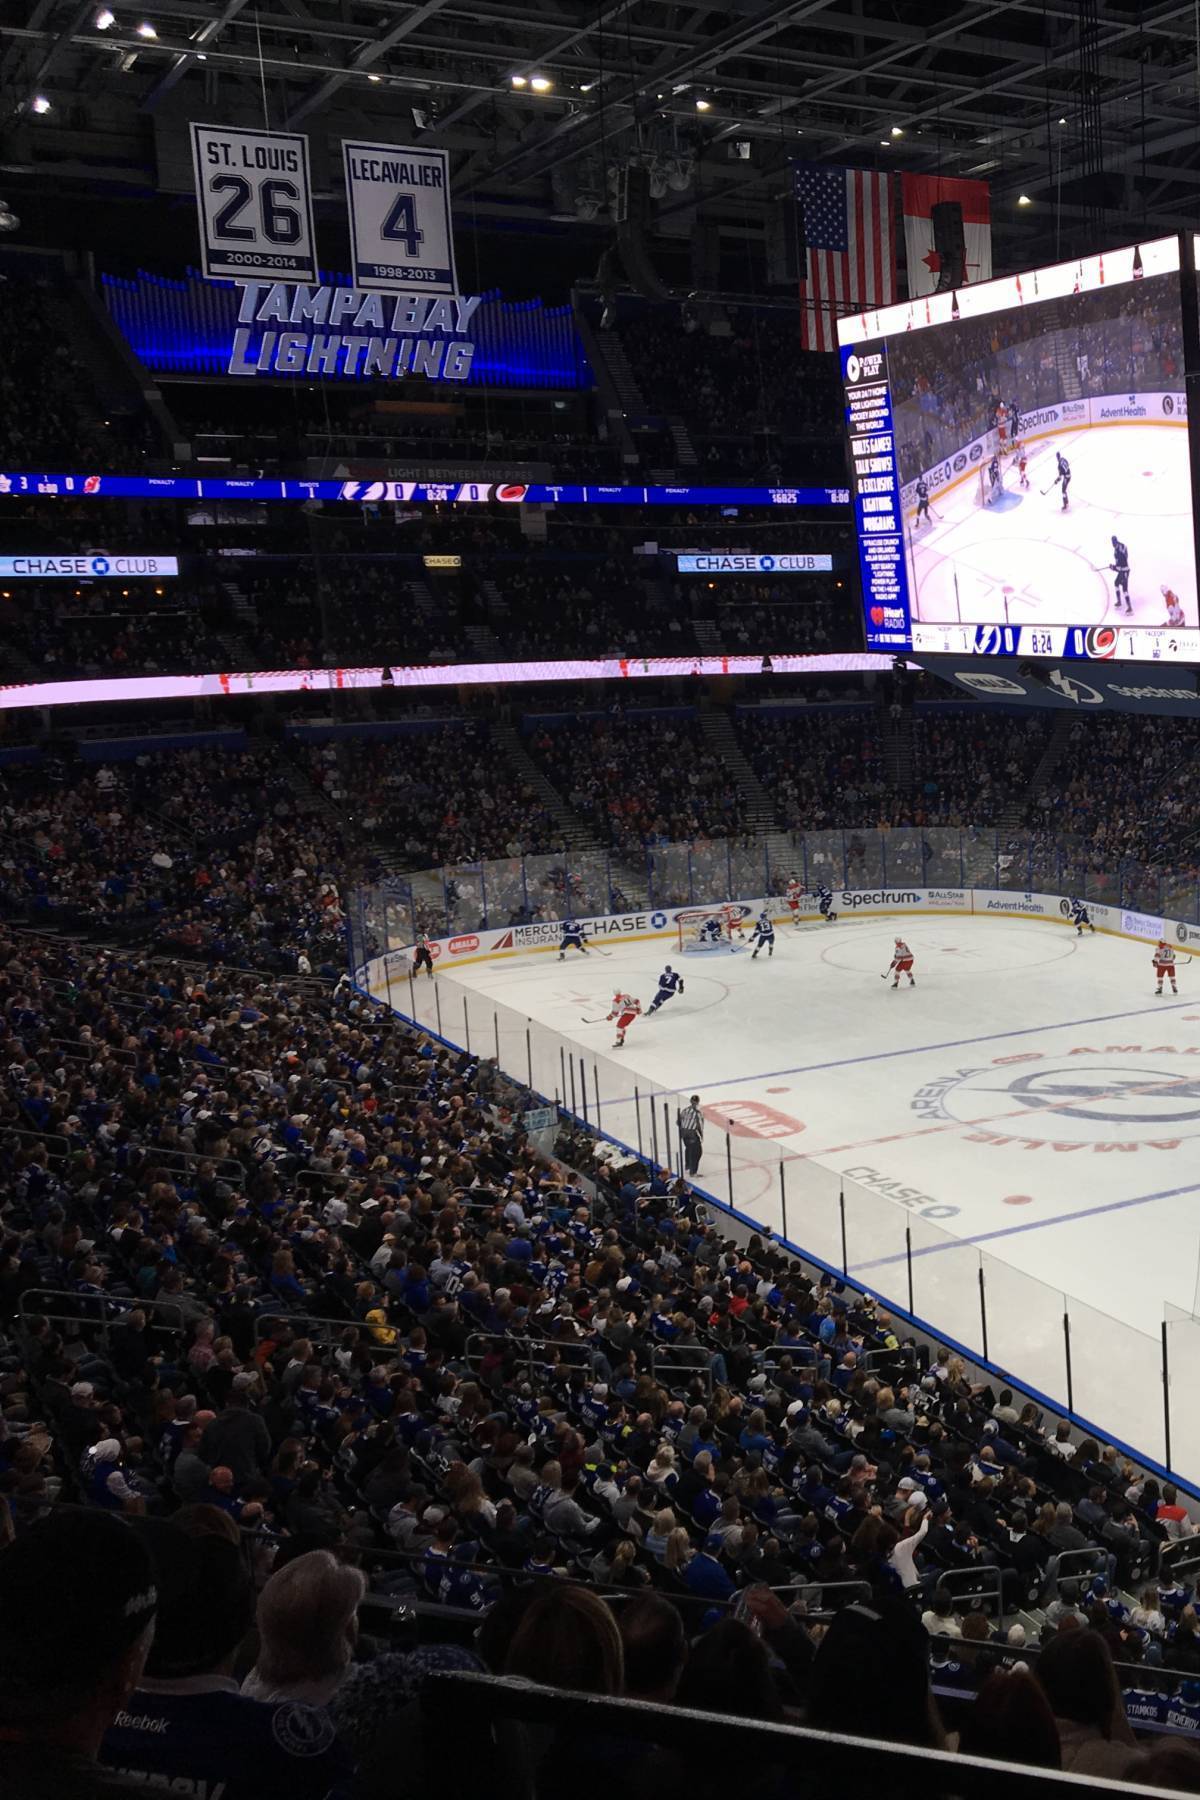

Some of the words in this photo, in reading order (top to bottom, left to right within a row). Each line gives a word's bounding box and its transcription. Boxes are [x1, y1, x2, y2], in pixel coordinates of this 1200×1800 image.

[207, 142, 237, 166] ST.
[243, 145, 298, 172] LOUIS
[352, 158, 442, 188] LECAVALIER
[210, 173, 303, 245] 26
[380, 192, 424, 258] 4
[226, 252, 297, 268] 2000-2014
[373, 265, 436, 281] 1998-2013
[234, 281, 384, 328] TAMPA
[391, 295, 481, 333] BAY
[228, 328, 475, 379] LIGHTNING
[863, 364, 880, 377] PLAY
[13, 559, 87, 574] CHASE
[116, 558, 158, 573] CLUB
[696, 557, 756, 569] CHASE
[779, 556, 815, 569] CLUB
[884, 618, 905, 629] RADIO
[1031, 634, 1053, 654] 8:24
[842, 890, 917, 908] Spectrum
[987, 899, 1044, 913] AdventHealth
[515, 922, 565, 937] MERCUR
[582, 915, 647, 937] CHASE
[760, 921, 770, 932] 13
[515, 934, 564, 947] INSURAN
[911, 1067, 990, 1120] ARENA
[841, 1165, 938, 1208] CHASE
[113, 1709, 172, 1735] Reebok
